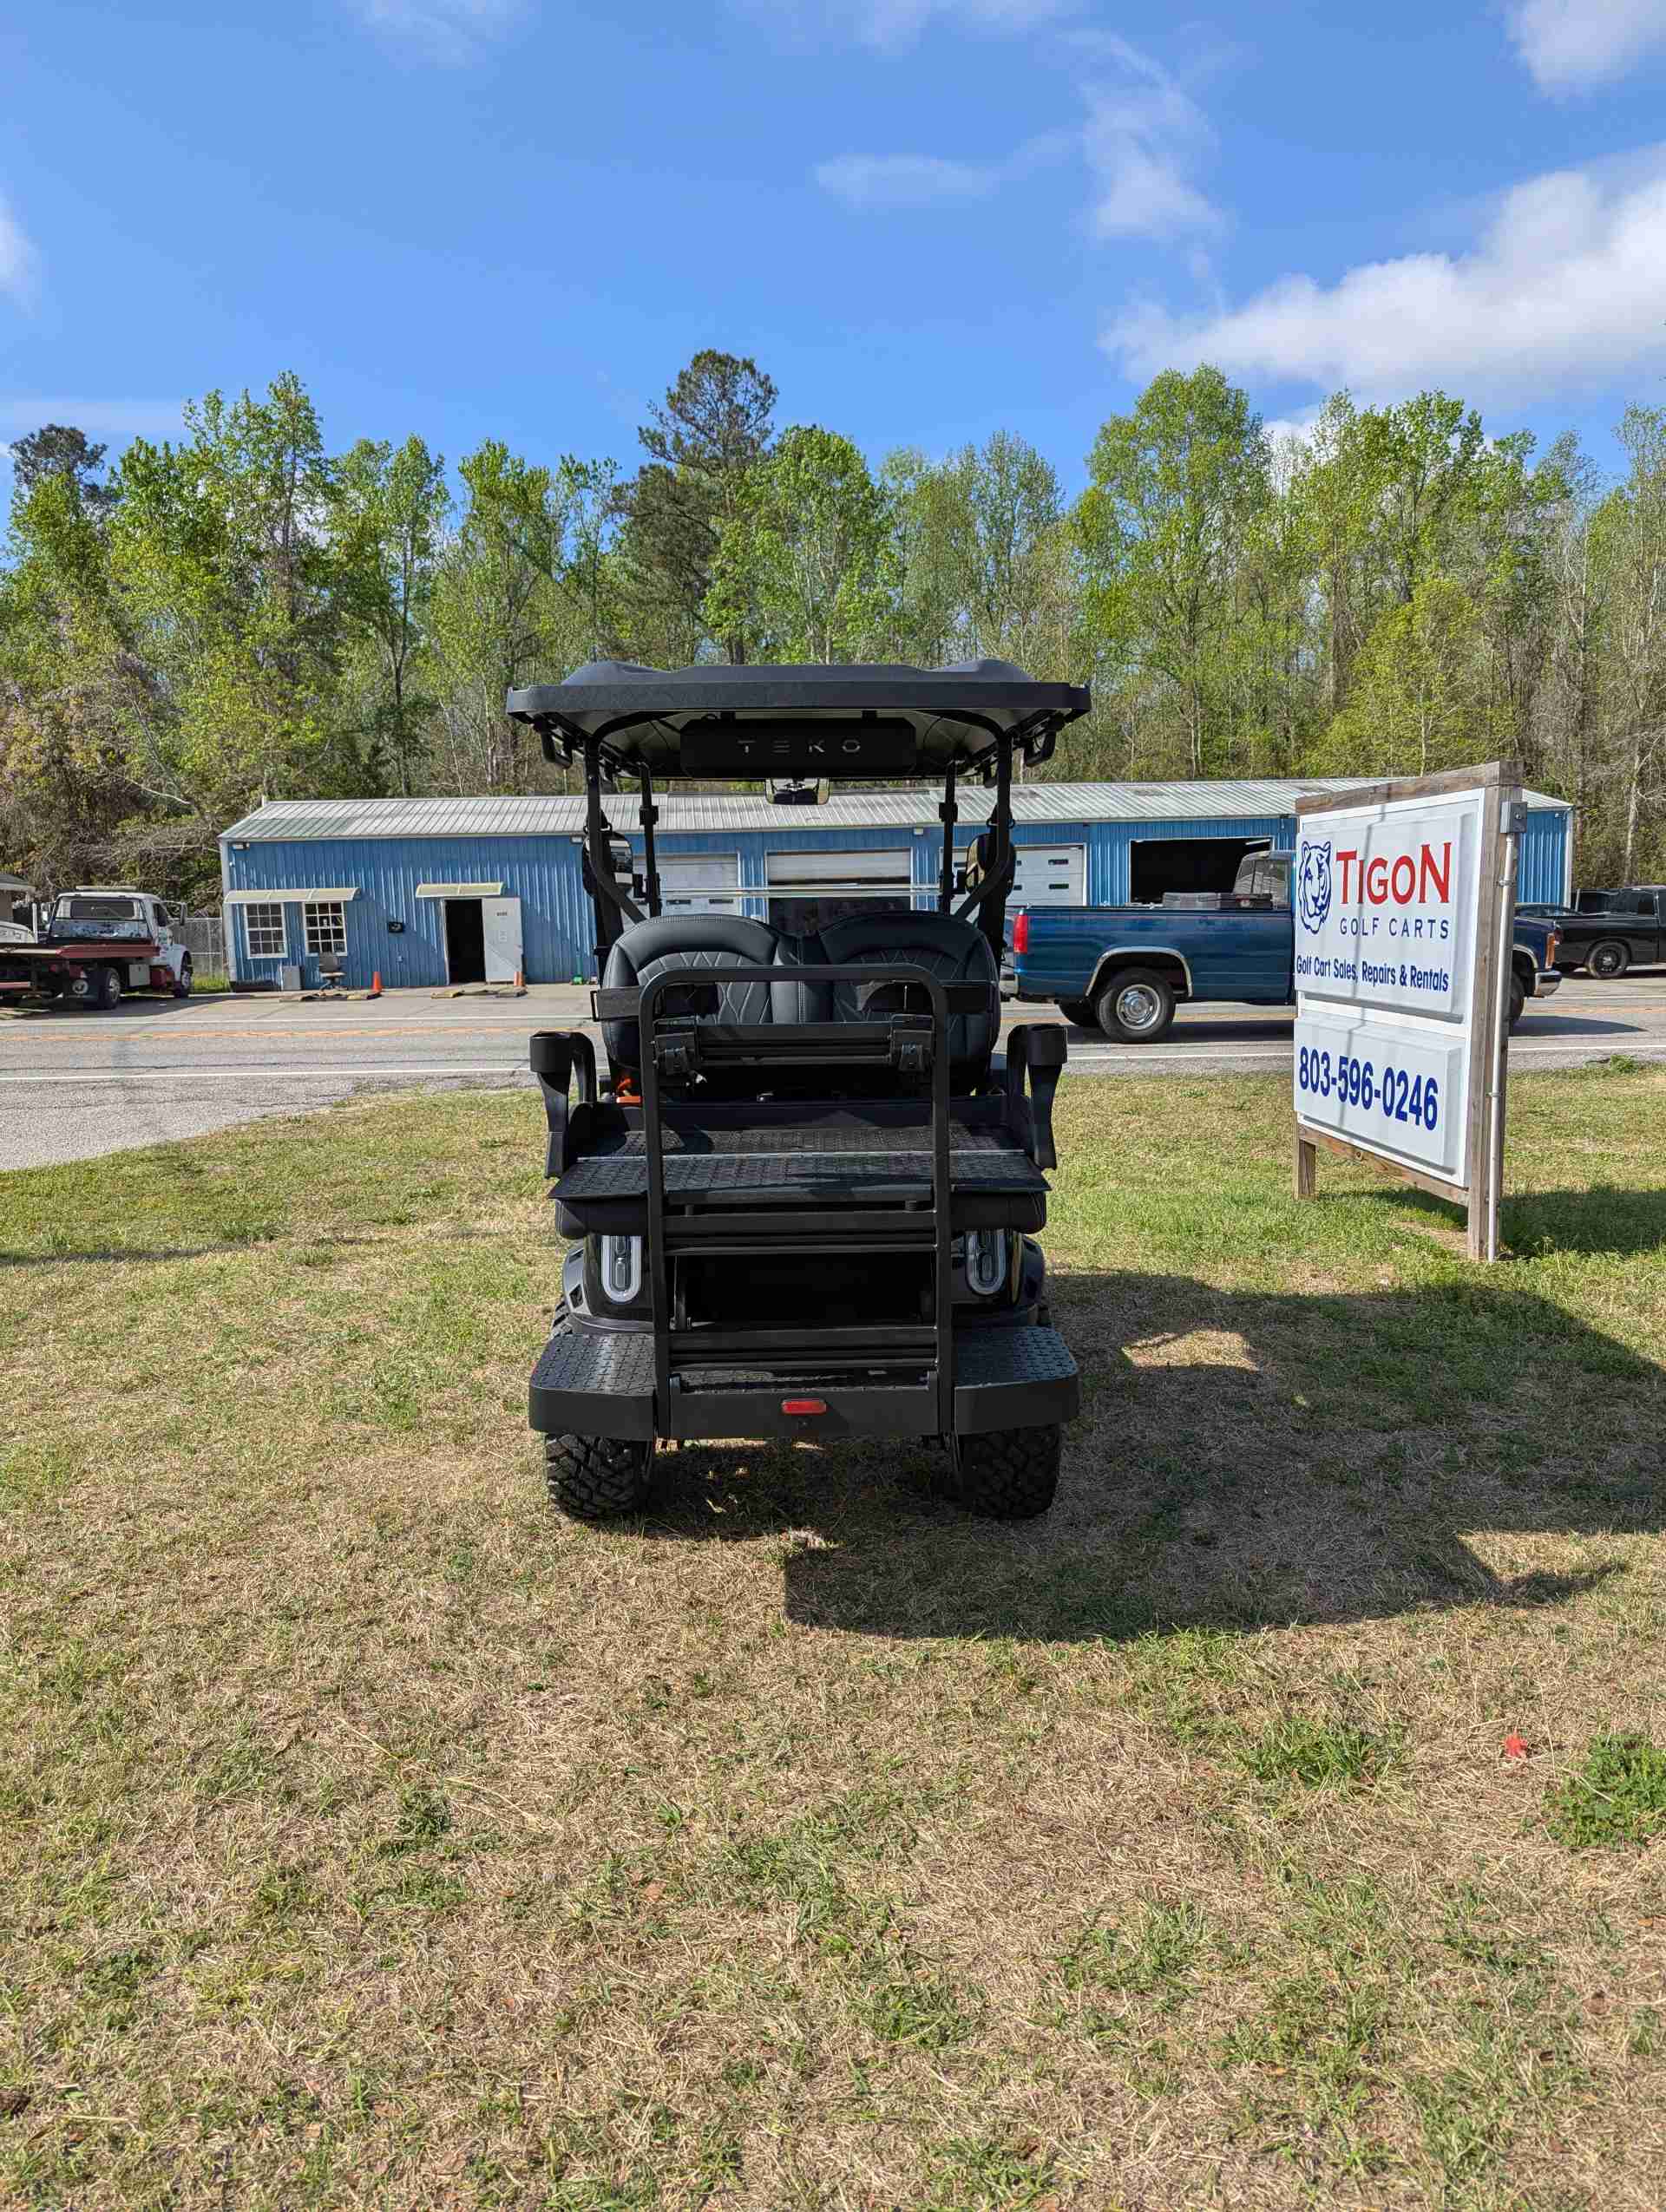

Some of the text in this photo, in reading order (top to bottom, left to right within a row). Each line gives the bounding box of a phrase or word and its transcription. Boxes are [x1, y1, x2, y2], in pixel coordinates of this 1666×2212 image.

[738, 739, 861, 753] TEKO
[1336, 842, 1452, 905] TIGON
[1340, 918, 1449, 939] GOLF CARTS
[1296, 955, 1449, 992] Golf Cart Sales, Repairs & Rentals
[1299, 1046, 1439, 1131] 803-596-0246
